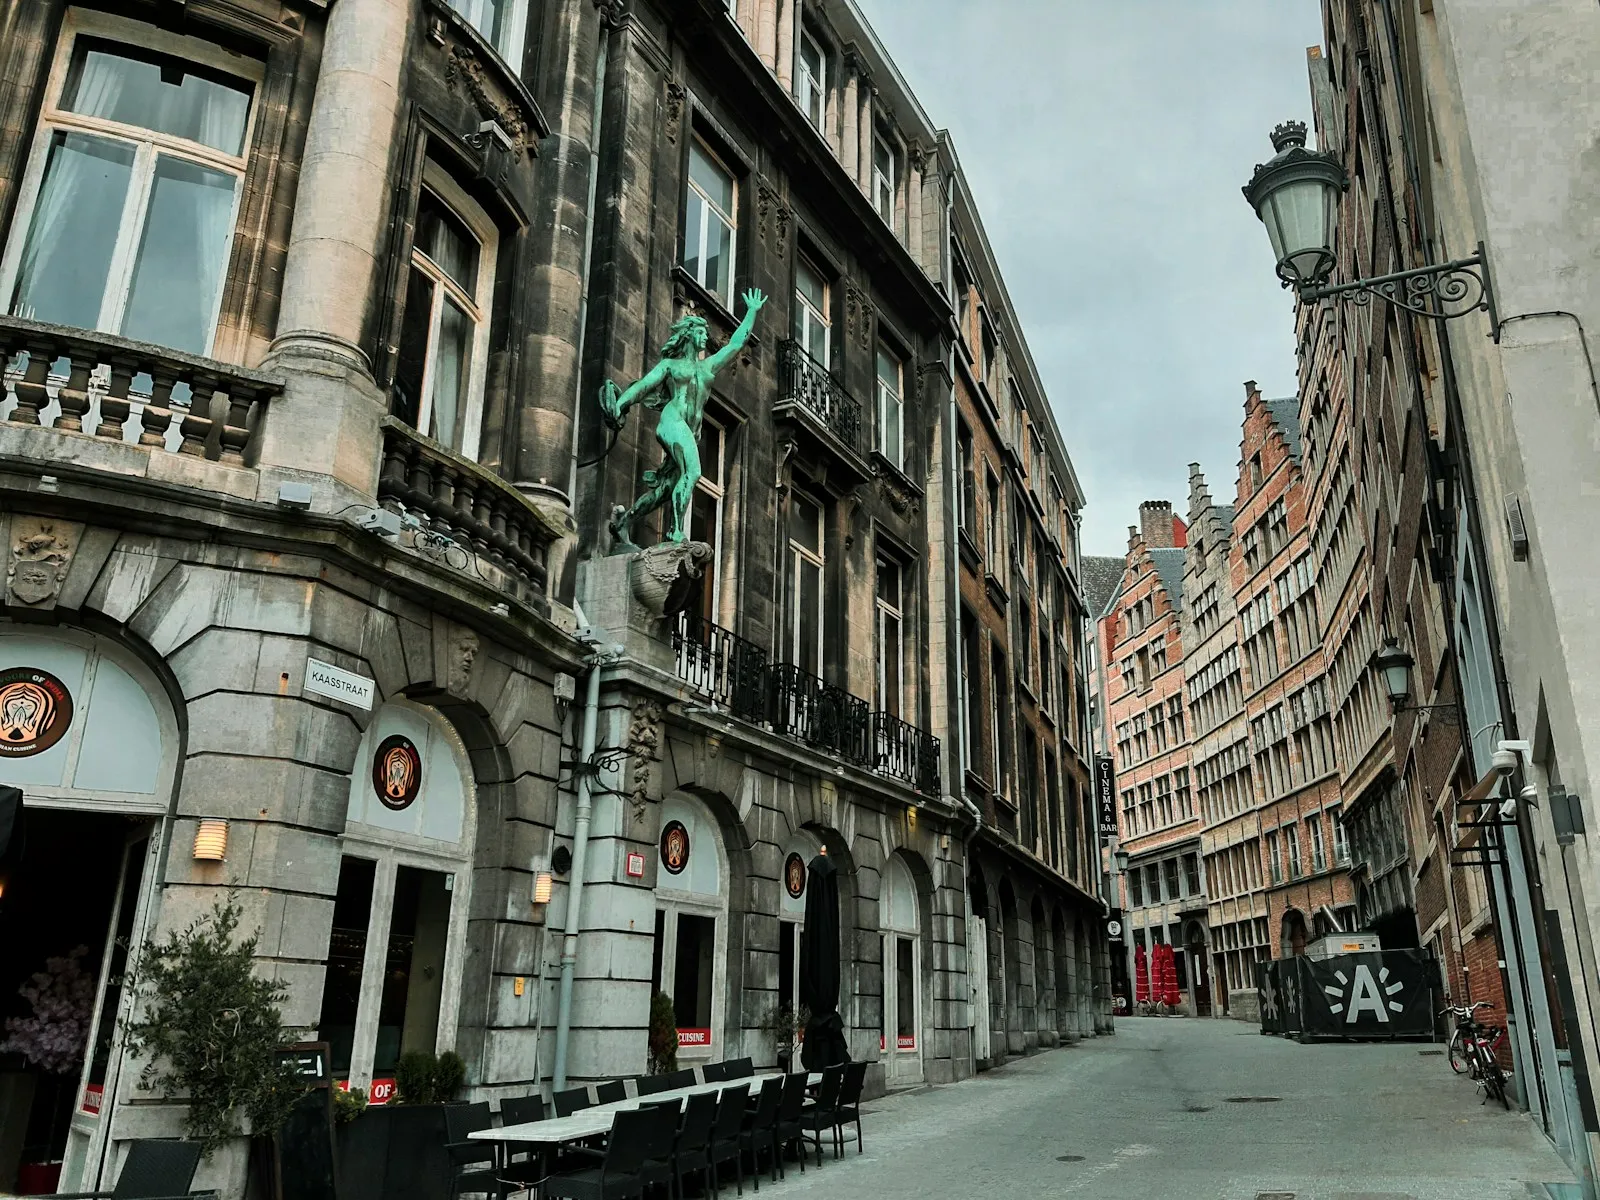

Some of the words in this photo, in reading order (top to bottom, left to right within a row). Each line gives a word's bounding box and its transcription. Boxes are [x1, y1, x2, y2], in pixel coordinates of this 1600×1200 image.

[32, 674, 45, 683] OF
[312, 671, 368, 697] KAASSTRAAT
[1101, 762, 1111, 812] CINEMA
[1100, 823, 1117, 832] BAR
[1345, 964, 1390, 1024] A
[677, 1032, 705, 1043] CUISINE
[374, 1084, 392, 1098] OF
